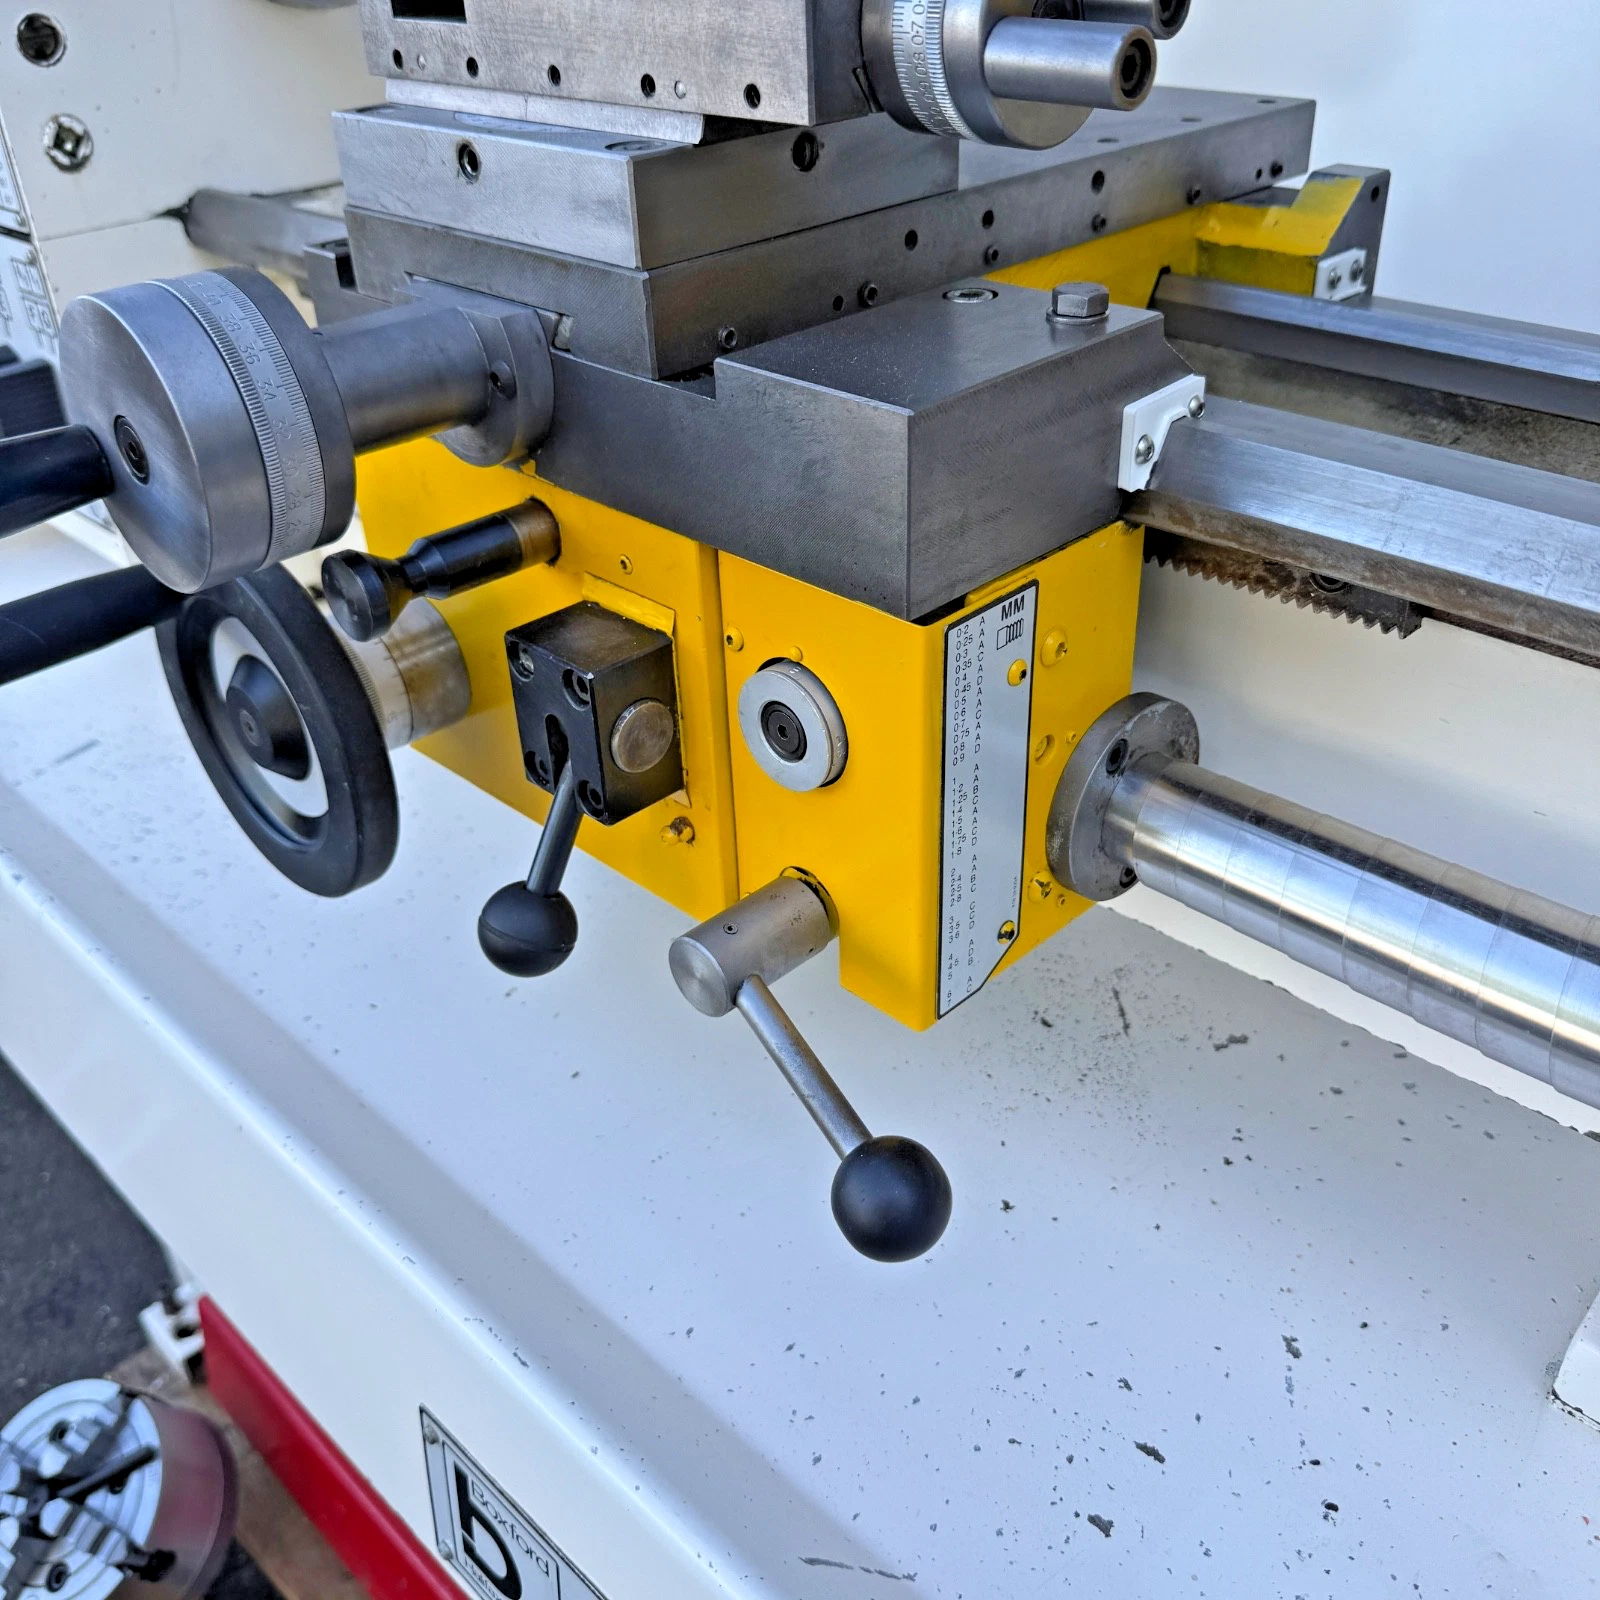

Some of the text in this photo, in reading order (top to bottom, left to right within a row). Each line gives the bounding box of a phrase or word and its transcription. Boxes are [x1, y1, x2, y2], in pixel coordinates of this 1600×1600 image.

[1001, 594, 1025, 621] MM
[979, 616, 985, 626] A
[979, 628, 984, 638] A
[979, 641, 984, 650] A
[977, 652, 984, 661] C
[978, 664, 983, 674] A
[977, 676, 982, 685] D
[977, 687, 982, 697] A
[976, 699, 982, 708] A
[976, 710, 981, 719] C
[976, 722, 981, 731] A
[975, 733, 980, 742] A
[975, 744, 980, 753] D
[974, 764, 979, 773] A
[973, 775, 978, 783] A
[973, 785, 978, 794] B
[973, 796, 978, 804] C
[973, 807, 978, 815] A
[972, 817, 977, 825] A
[972, 827, 977, 835] C
[972, 837, 977, 846] D
[471, 1479, 550, 1578] Boxford
